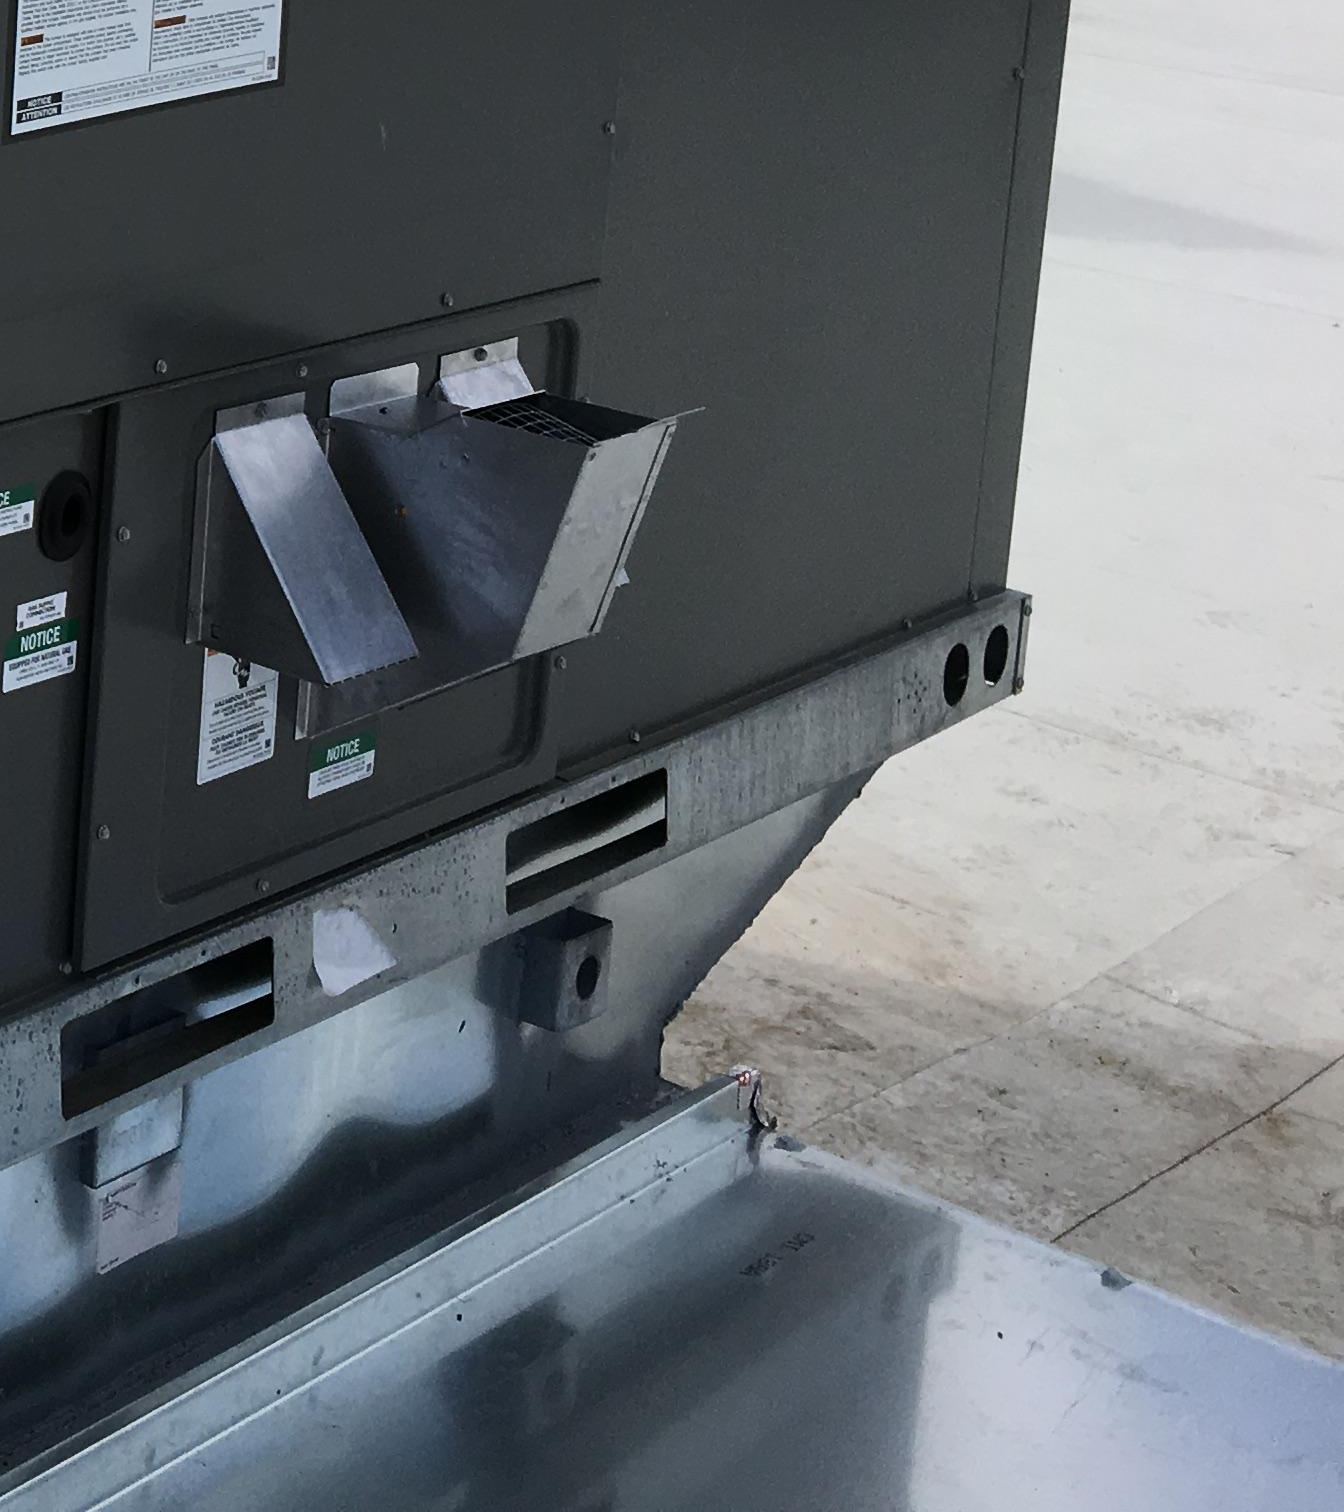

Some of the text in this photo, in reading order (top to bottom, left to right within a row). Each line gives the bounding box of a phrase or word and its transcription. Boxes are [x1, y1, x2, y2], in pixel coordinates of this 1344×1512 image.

[27, 95, 52, 108] NOTICE
[21, 106, 58, 121] ATTENTION
[20, 625, 61, 653] NOTICE
[326, 738, 360, 763] NOTICE
